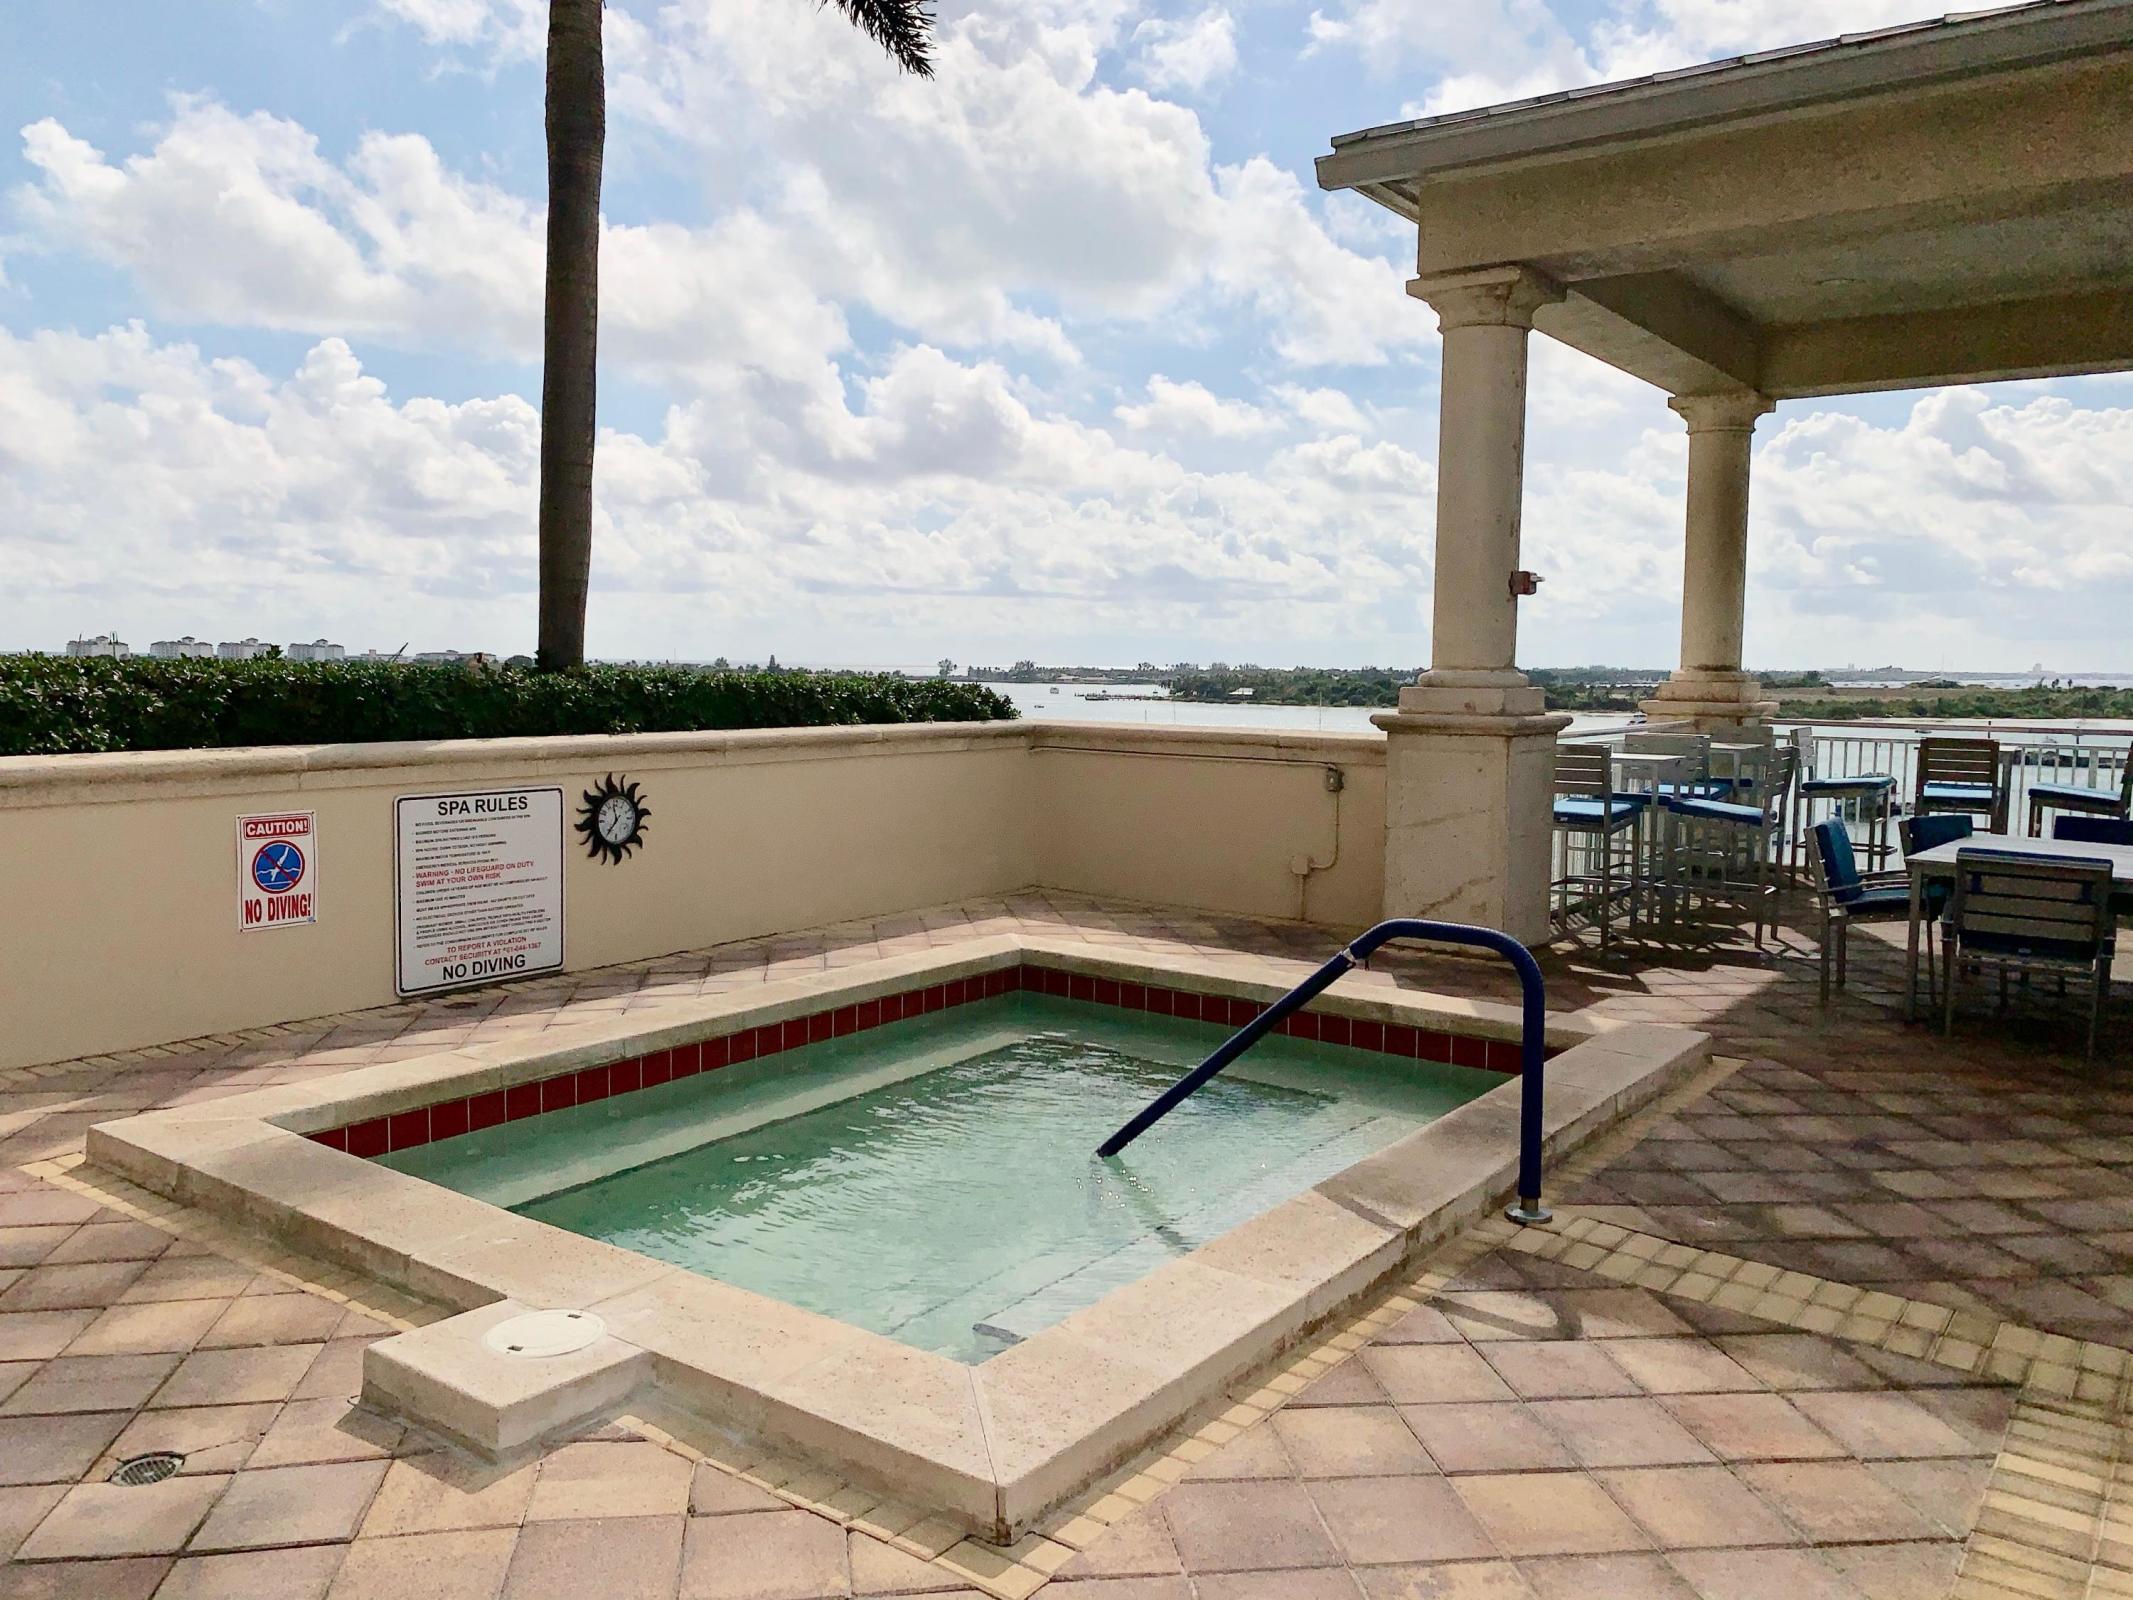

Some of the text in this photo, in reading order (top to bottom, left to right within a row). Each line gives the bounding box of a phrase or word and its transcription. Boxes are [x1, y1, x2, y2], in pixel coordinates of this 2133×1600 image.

[438, 796, 528, 816] SPA RULES
[246, 820, 308, 836] CAUTION!
[415, 870, 449, 879] WARNING
[454, 867, 466, 875] NO
[466, 863, 505, 874] LIFEGUARD
[505, 863, 516, 871] ON
[517, 860, 534, 869] DUTY
[416, 872, 502, 888] SWIM AT YOUR OWN RISK
[245, 893, 311, 924] NO DIVING!
[447, 946, 457, 954] TO
[457, 942, 485, 952] REPORT
[493, 936, 527, 948] VIOLATION
[424, 955, 457, 966] CONTACT
[459, 950, 492, 961] SECURITY
[493, 948, 502, 956] AT
[442, 954, 526, 981] NO DIVING
